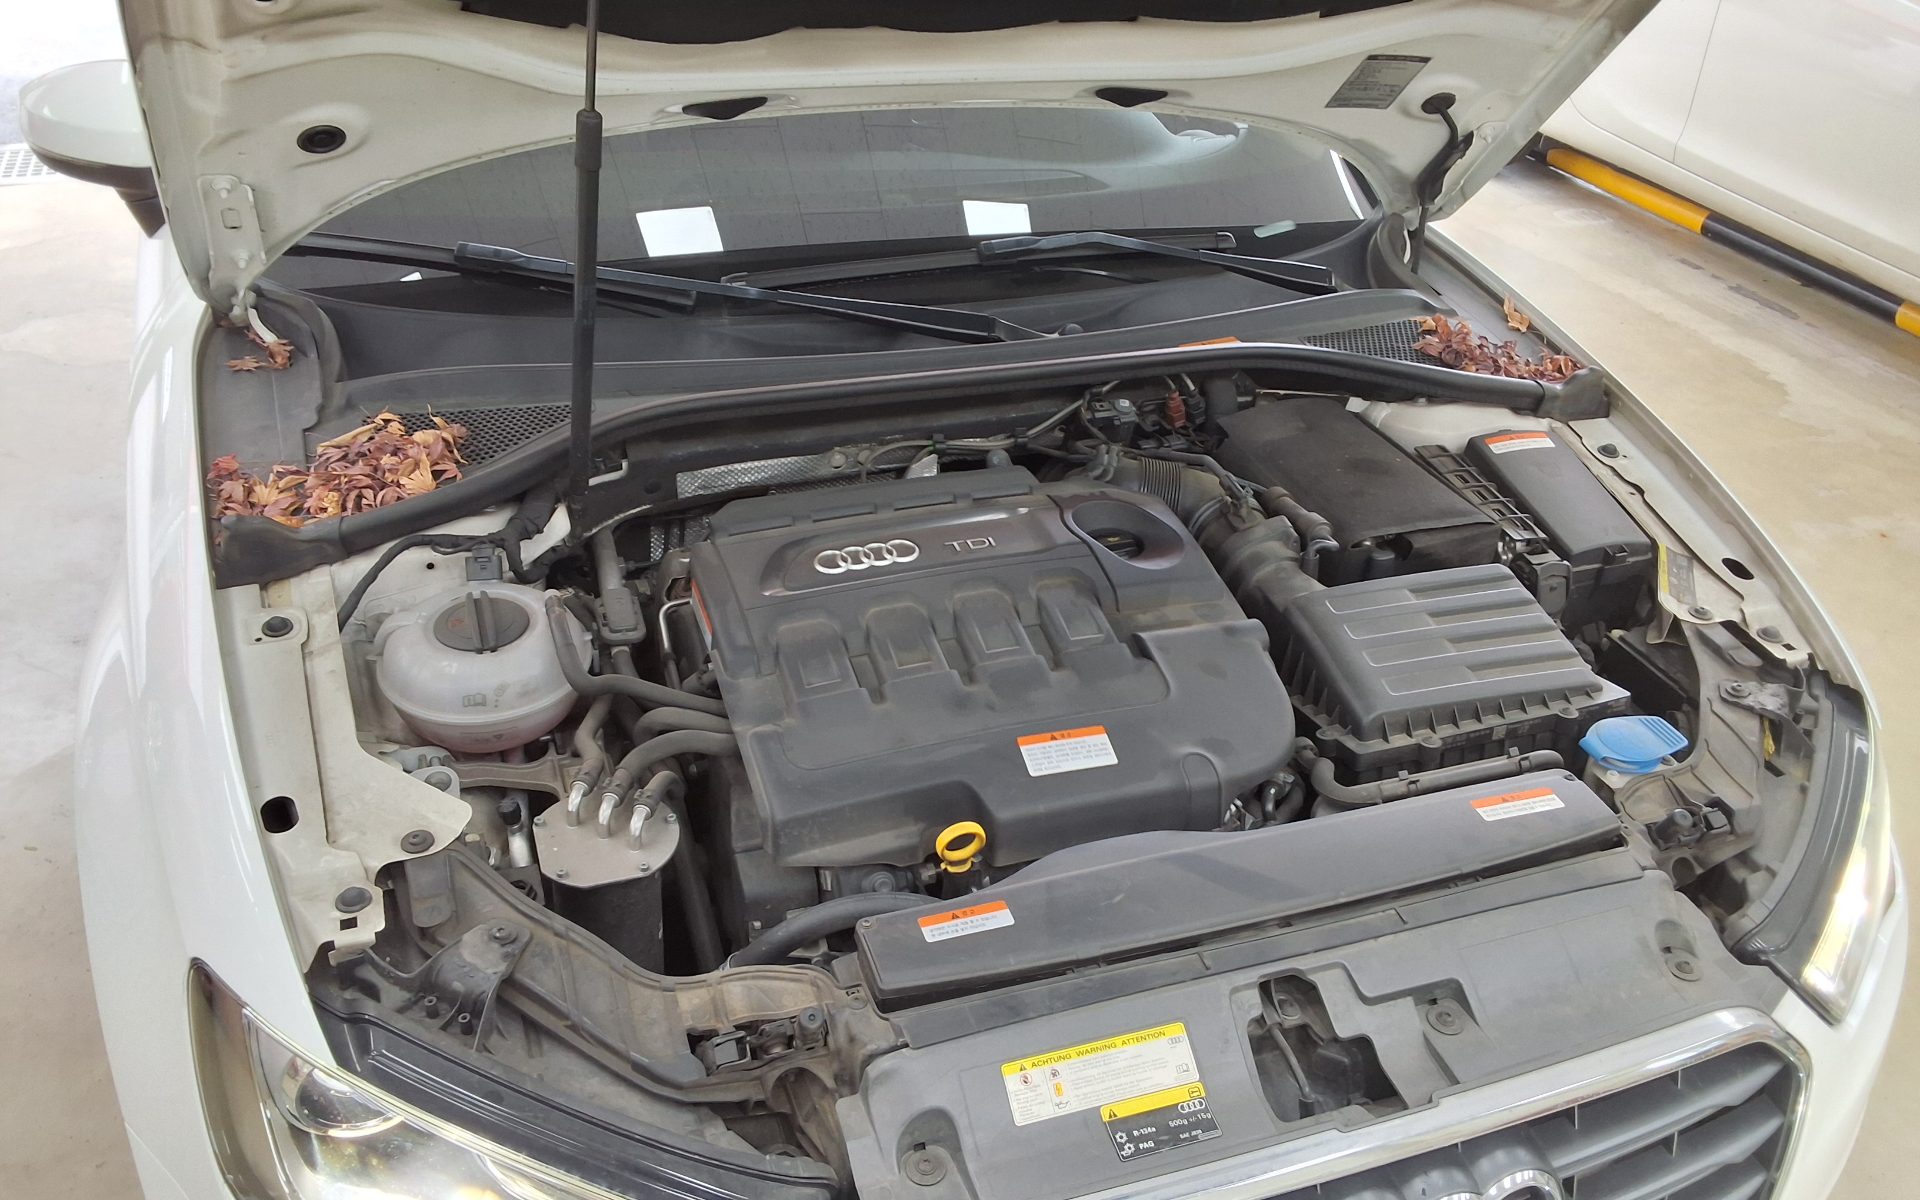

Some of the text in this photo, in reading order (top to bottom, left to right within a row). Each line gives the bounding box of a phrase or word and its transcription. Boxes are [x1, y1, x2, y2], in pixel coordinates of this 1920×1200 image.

[943, 536, 997, 552] TDI
[1031, 1030, 1166, 1069] ACHTUNG WARNING ATTENTION
[1138, 1140, 1155, 1150] PAG
